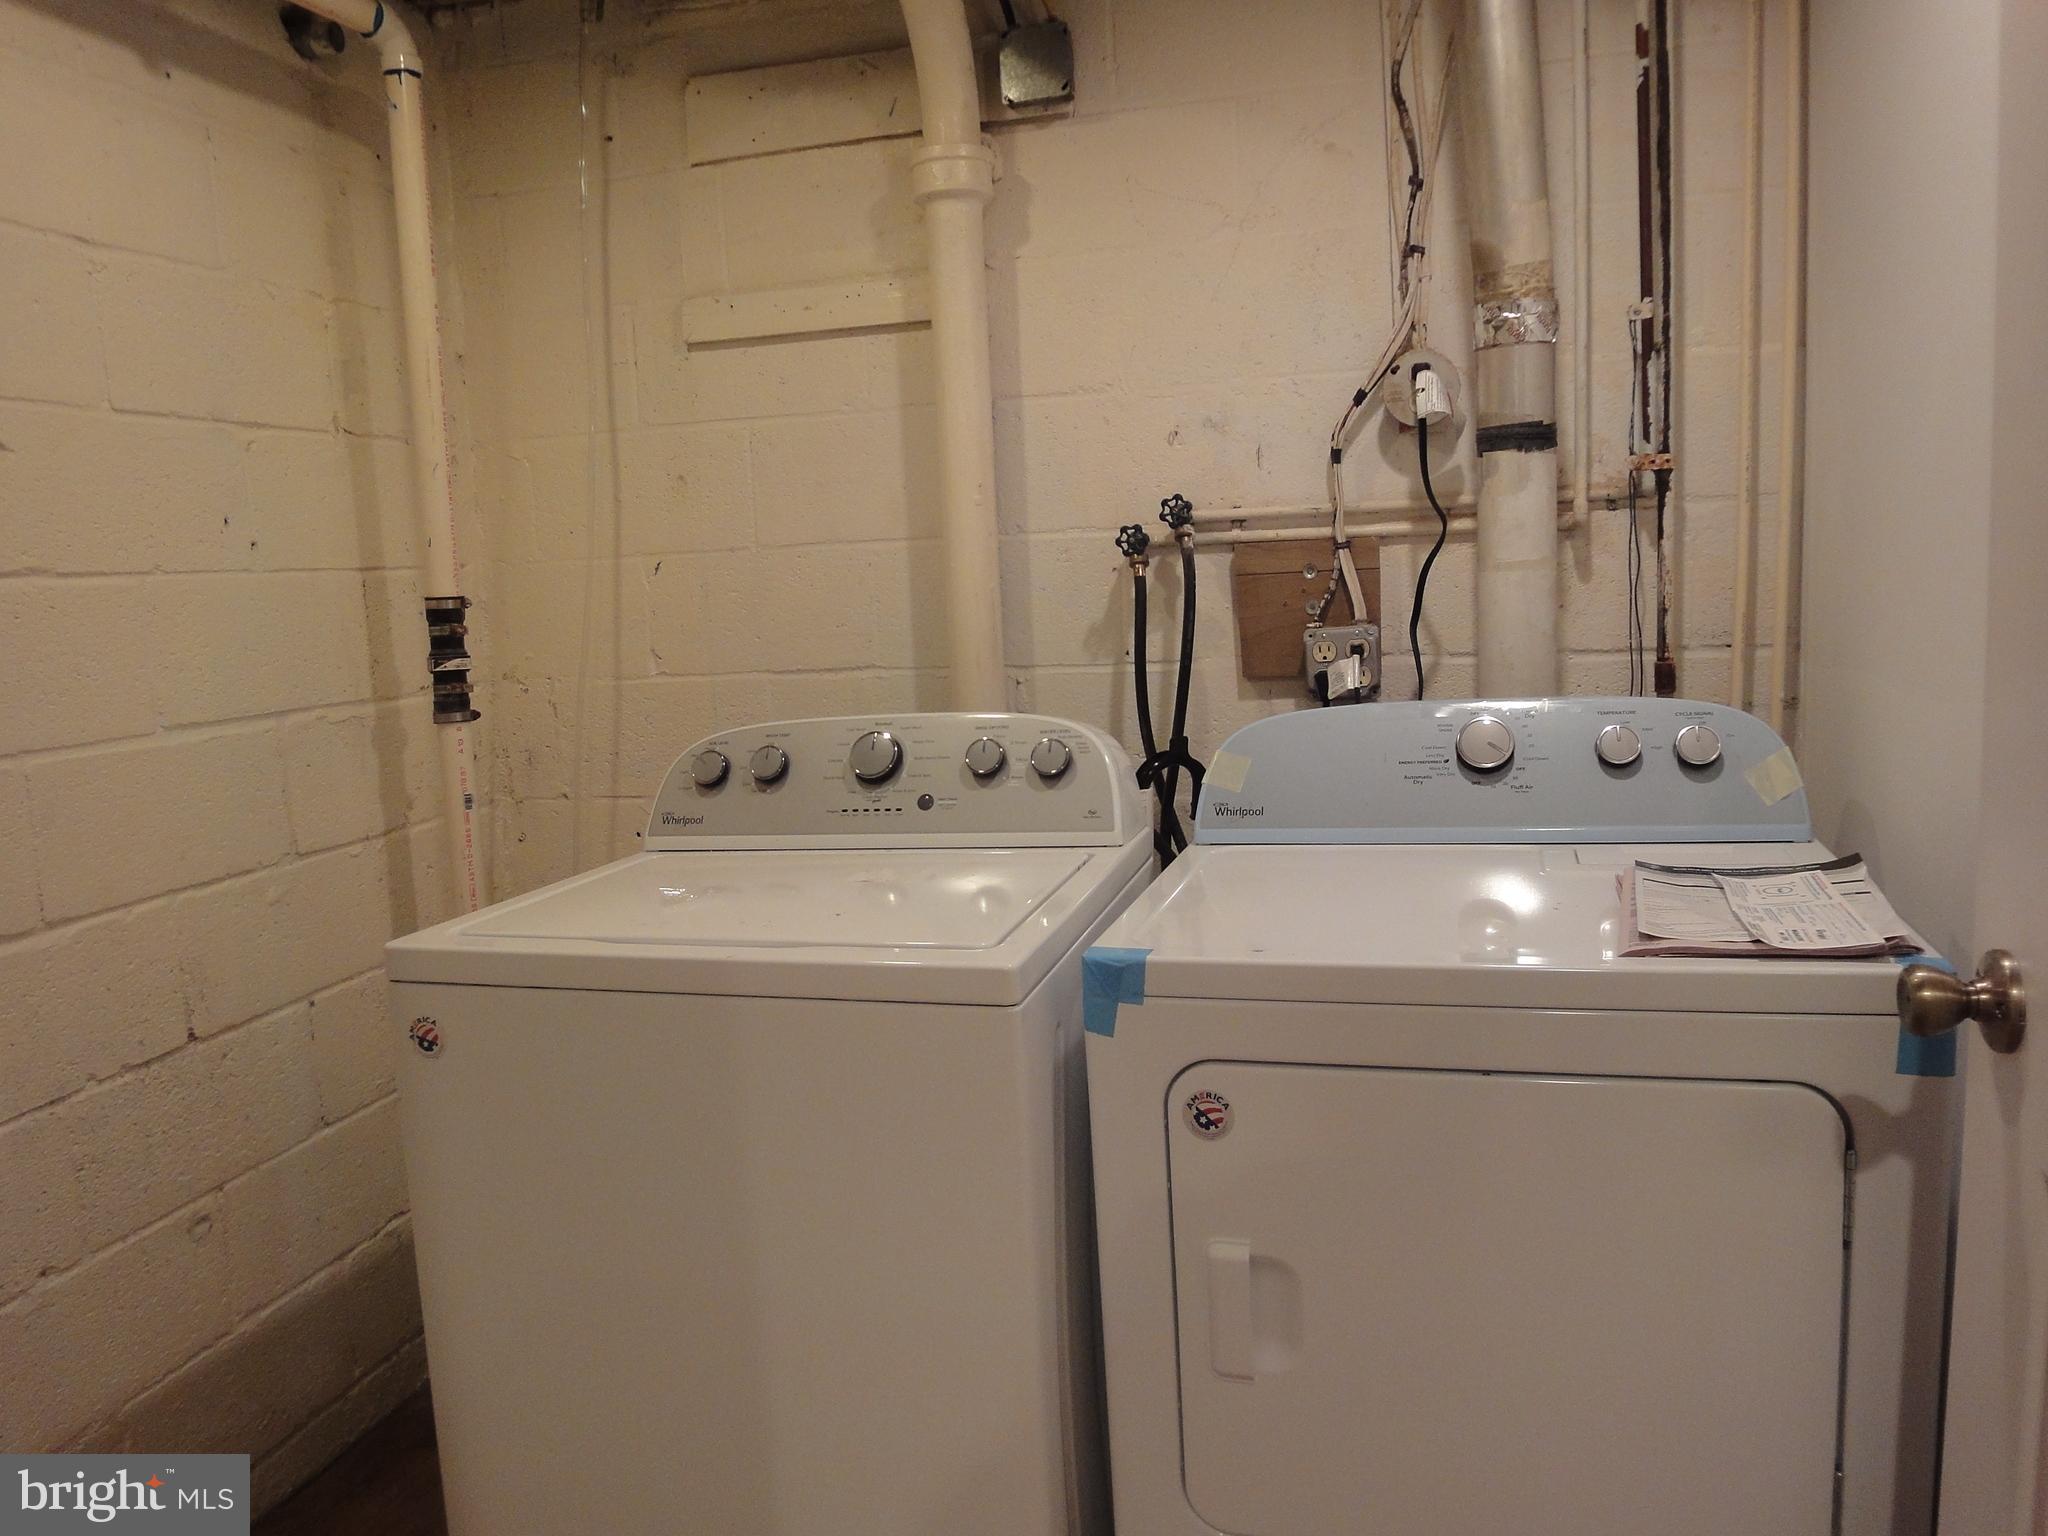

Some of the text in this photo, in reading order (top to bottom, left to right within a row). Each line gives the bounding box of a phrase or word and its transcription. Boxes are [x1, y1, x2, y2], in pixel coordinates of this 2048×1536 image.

[1214, 806, 1264, 819] Whirlpool
[662, 815, 704, 827] Whirlpool
[1186, 1091, 1230, 1111] AMERICA
